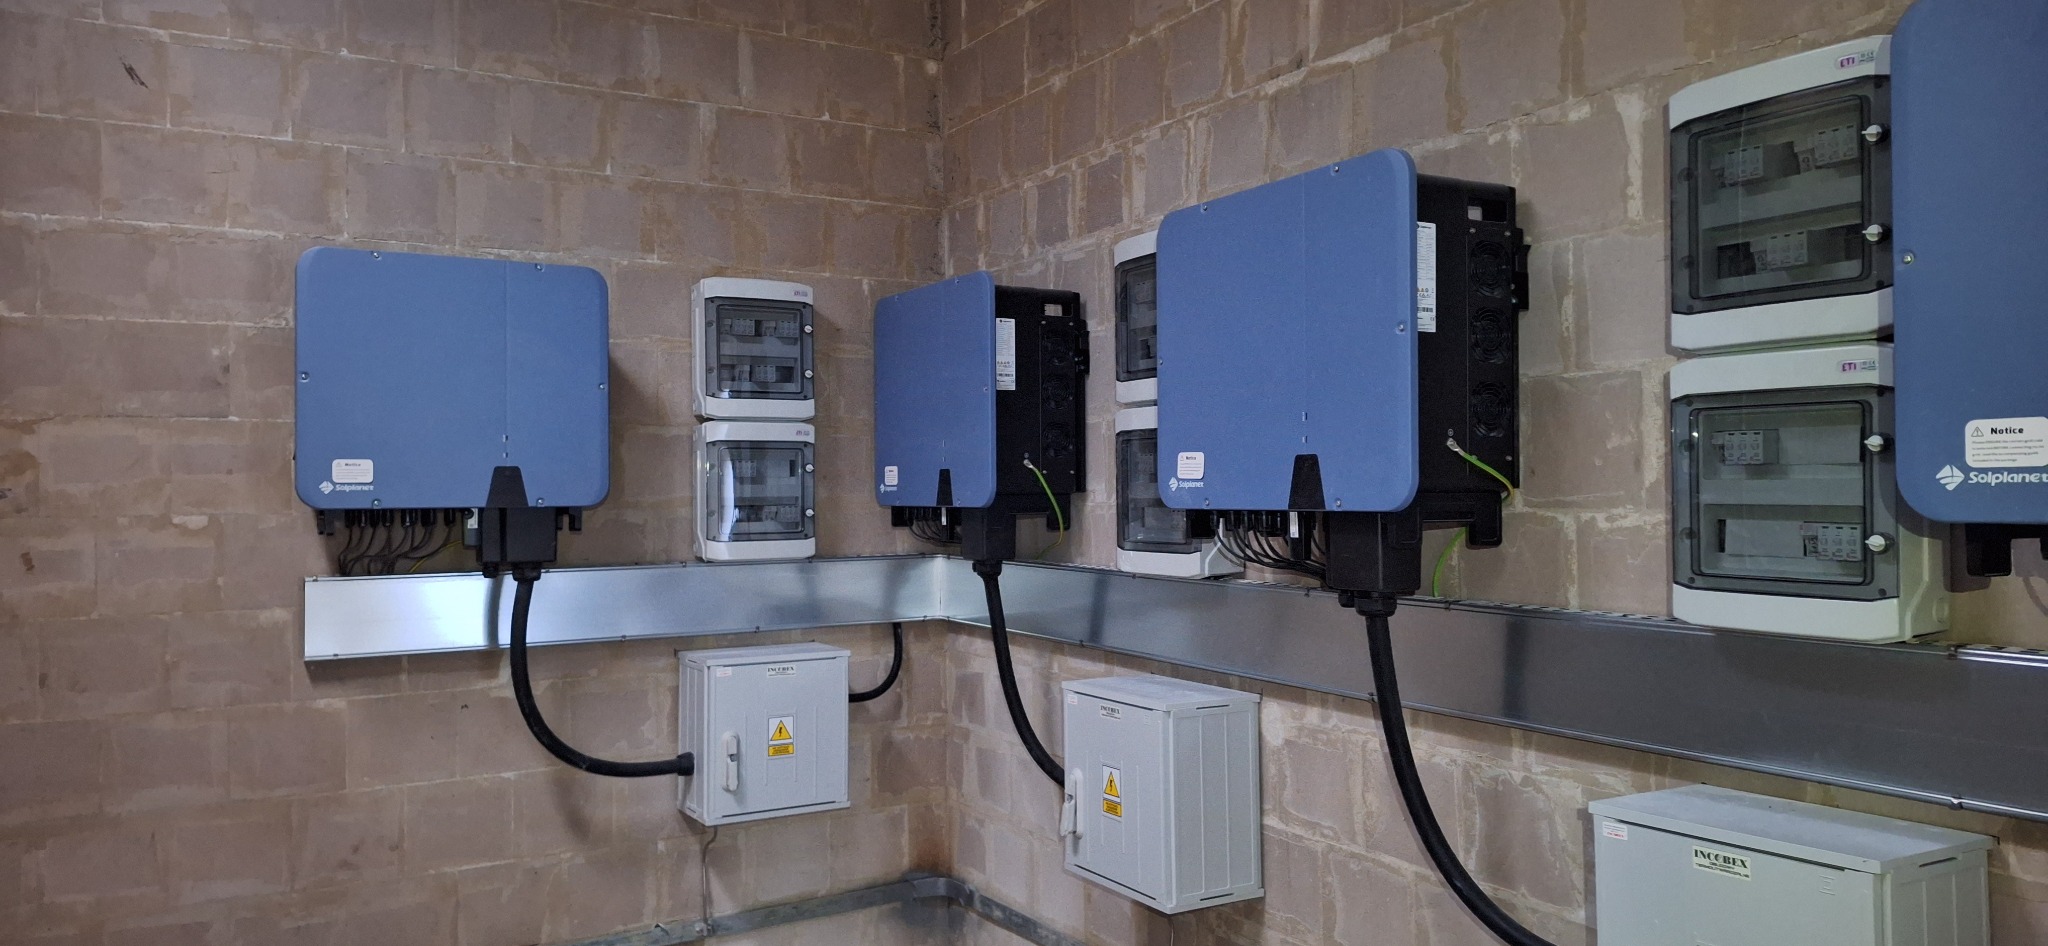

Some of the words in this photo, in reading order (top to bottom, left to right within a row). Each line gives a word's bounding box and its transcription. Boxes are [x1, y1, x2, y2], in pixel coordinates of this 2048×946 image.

[1842, 362, 1857, 372] ETI
[1990, 426, 2025, 435] Notice
[1968, 471, 2048, 486] Solplanet
[335, 484, 374, 492] Solplanet
[1694, 849, 1748, 869] INCOBEX
